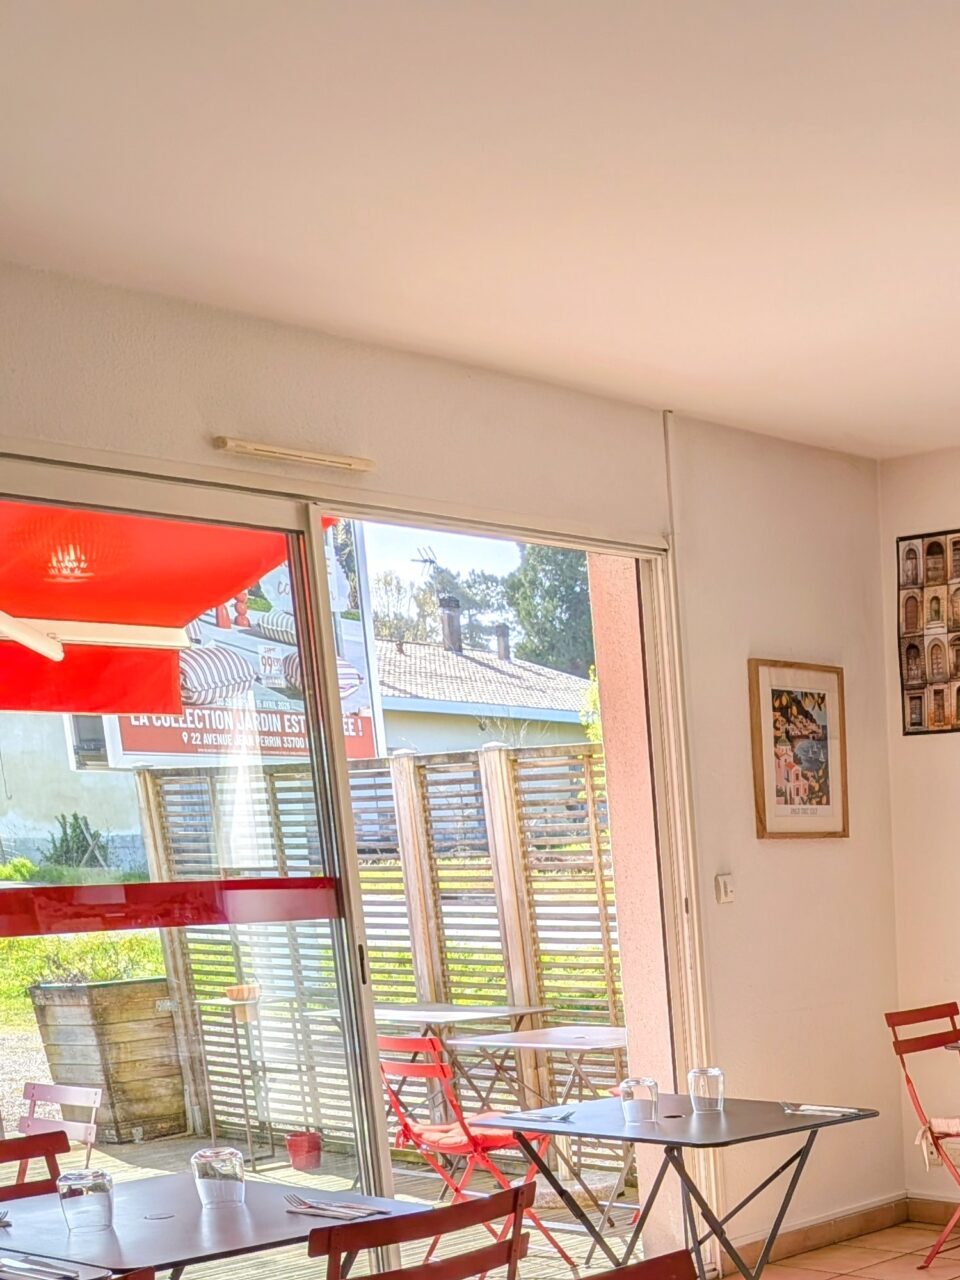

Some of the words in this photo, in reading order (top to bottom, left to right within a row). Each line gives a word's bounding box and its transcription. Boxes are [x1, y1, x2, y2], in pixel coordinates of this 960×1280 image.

[130, 716, 149, 726] LA
[152, 710, 233, 730] COLLECTION
[236, 713, 281, 733] JARDIN
[284, 715, 306, 734] EST
[191, 733, 201, 745] 22
[203, 734, 233, 746] AVENUE
[255, 736, 282, 749] PERRIN
[283, 737, 305, 749] 33700
